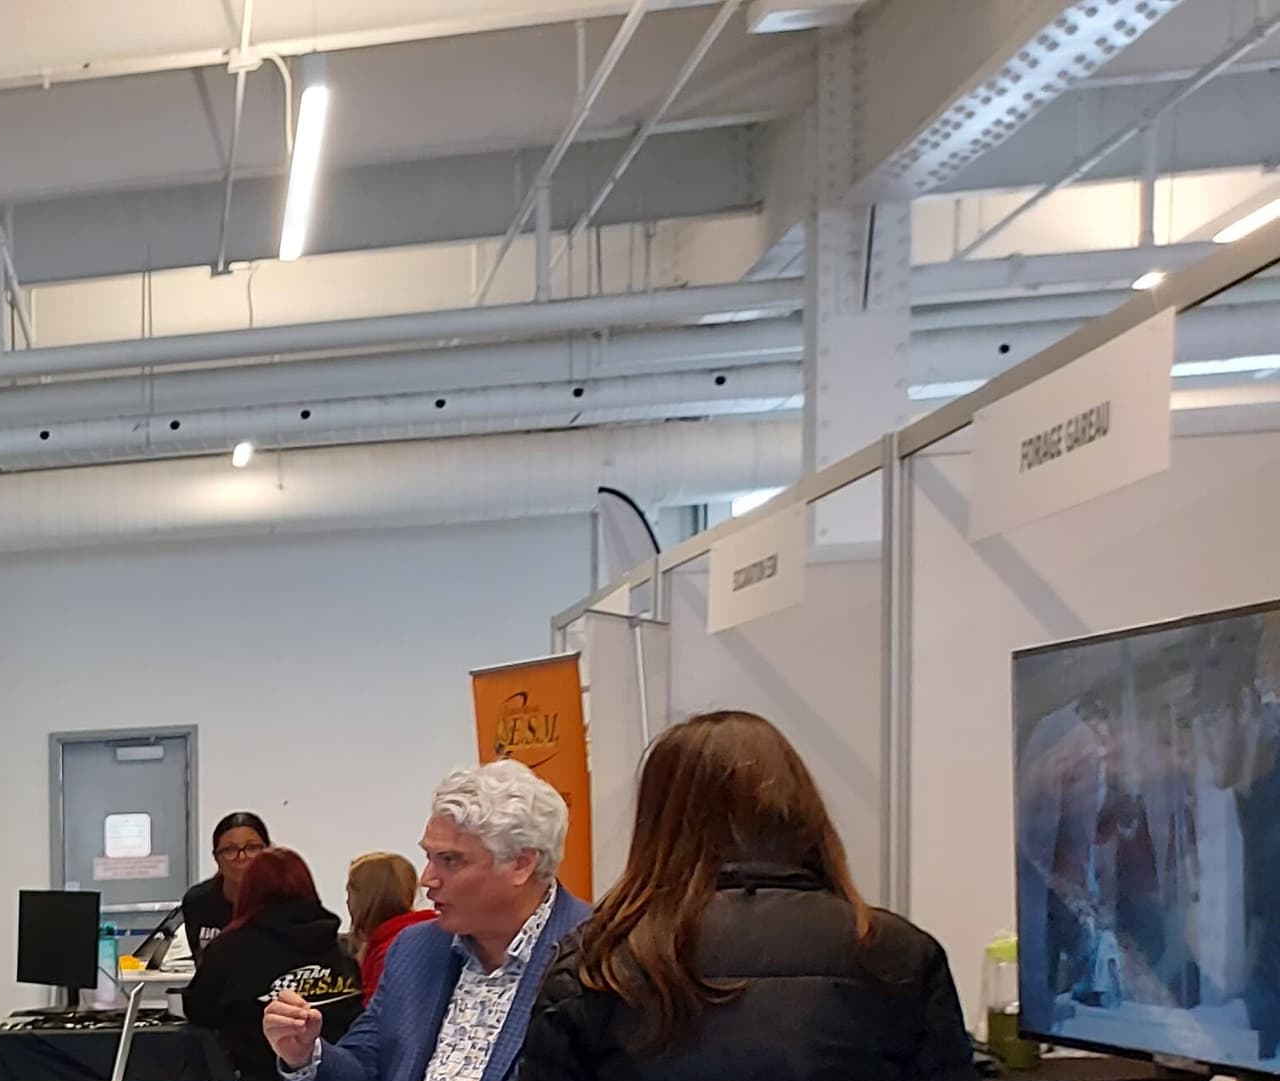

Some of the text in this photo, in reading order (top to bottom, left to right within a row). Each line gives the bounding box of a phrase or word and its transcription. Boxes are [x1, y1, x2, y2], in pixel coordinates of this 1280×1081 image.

[1020, 401, 1110, 472] FORAGE GAREAU
[296, 969, 331, 980] TEAM
